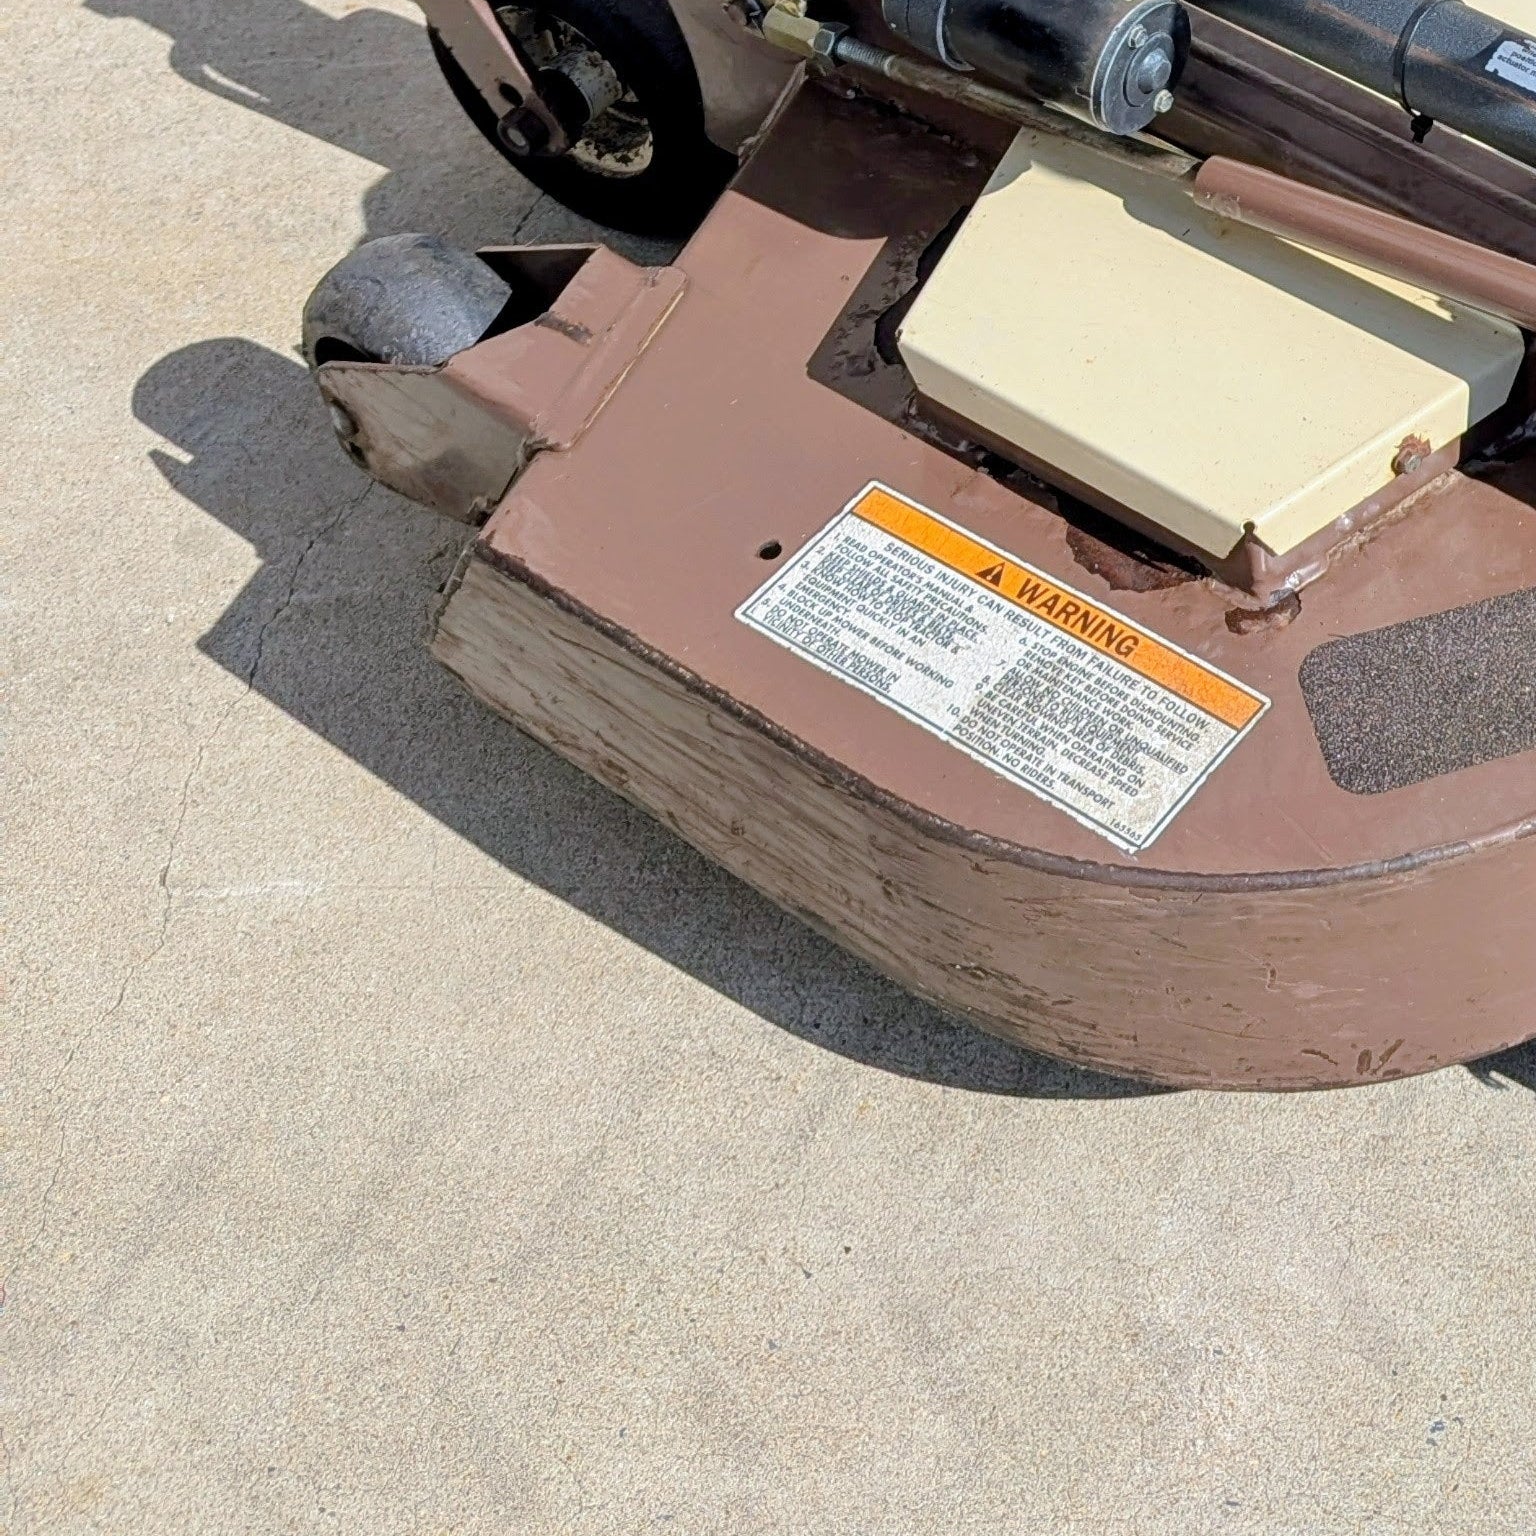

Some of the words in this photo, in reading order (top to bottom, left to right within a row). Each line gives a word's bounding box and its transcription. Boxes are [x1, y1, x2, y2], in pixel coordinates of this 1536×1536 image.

[793, 581, 853, 618] EMERGENCY.
[817, 558, 843, 575] KEEP
[840, 571, 871, 592] CLEAR
[868, 587, 885, 600] OF
[882, 595, 918, 618] DRIVES
[915, 614, 928, 624] &
[825, 550, 851, 568] KEEP
[848, 563, 887, 588] SHIELDS
[885, 584, 896, 593] &
[893, 589, 937, 616] GUARDS
[934, 612, 949, 624] IN
[833, 542, 874, 568] FOLLOW
[872, 564, 891, 578] ALL
[889, 574, 924, 596] SAFETY
[841, 535, 869, 553] READ
[922, 580, 965, 607] MANUAL
[964, 604, 975, 613] &
[760, 612, 802, 639] VICINITY
[799, 635, 817, 648] OF
[814, 643, 848, 666] OTHER
[769, 604, 788, 618] DO
[785, 613, 809, 630] NOT
[806, 626, 850, 654] OPERATE
[847, 649, 888, 676] MOWER
[884, 671, 900, 683] IN
[777, 596, 843, 637] UNDERNEATH.
[786, 588, 819, 610] BLOCK
[816, 606, 833, 618] UP
[831, 615, 870, 640] MOWER
[868, 636, 905, 660] BEFORE
[903, 656, 955, 689] WORKING
[801, 573, 856, 607] EQUIPMENT
[854, 603, 897, 630] QUICKLY
[895, 626, 910, 638] IN
[907, 633, 927, 647] AN
[809, 565, 844, 588] KNOW
[841, 583, 870, 602] HOW
[867, 598, 884, 611] TO
[881, 606, 909, 625] STOP
[906, 620, 952, 649] TRACTOR
[949, 645, 962, 655] &
[881, 541, 936, 575] SERIOUS
[932, 569, 978, 599] INJURY
[974, 593, 1005, 614] CAN
[1001, 608, 1052, 640] RESULT
[1048, 634, 1088, 661] FROM
[1085, 655, 1141, 691] FAILURE
[1138, 685, 1160, 701] TO
[1015, 577, 1140, 657] WARNING
[998, 674, 1045, 704] PERSONS
[1043, 699, 1061, 713] TO
[1058, 708, 1083, 725] RUN
[1014, 657, 1032, 671] OR
[1030, 666, 1101, 710] MAINTENANCE
[1021, 649, 1064, 677] REMOVE
[1062, 672, 1084, 688] KEY
[1082, 684, 1121, 708] BEFORE
[1118, 704, 1155, 728] DOING
[1153, 724, 1195, 751] SERVICE
[1029, 641, 1057, 660] STOP
[1055, 656, 1094, 681] ENGINE
[1092, 677, 1130, 701] BEFORE
[967, 706, 1001, 729] WHEN
[974, 698, 1019, 727] UNEVEN
[1059, 747, 1109, 780] DECREASE
[1107, 775, 1140, 797] SPEED
[982, 690, 998, 702] BE
[996, 697, 1040, 726] CAREFUL
[1037, 721, 1072, 744] WHEN
[1069, 739, 1129, 777] OPERATING
[1126, 772, 1147, 787] ON
[990, 681, 1023, 703] CLEAR
[1021, 699, 1069, 730] MOWING
[1066, 725, 1096, 746] AREA
[1093, 741, 1112, 755] OF
[1005, 665, 1043, 690] ALLOW
[1040, 685, 1062, 701] NO
[1059, 696, 1108, 728] CHILDREN
[1106, 722, 1125, 737] OR
[1122, 732, 1190, 774] UNQUALIFIED
[958, 715, 978, 729] DO
[975, 725, 1001, 743] NOT
[998, 738, 1044, 768] OPERATE
[1041, 763, 1058, 776] IN
[1055, 771, 1115, 809] TRANSPORT
[1000, 752, 1021, 768] NO
